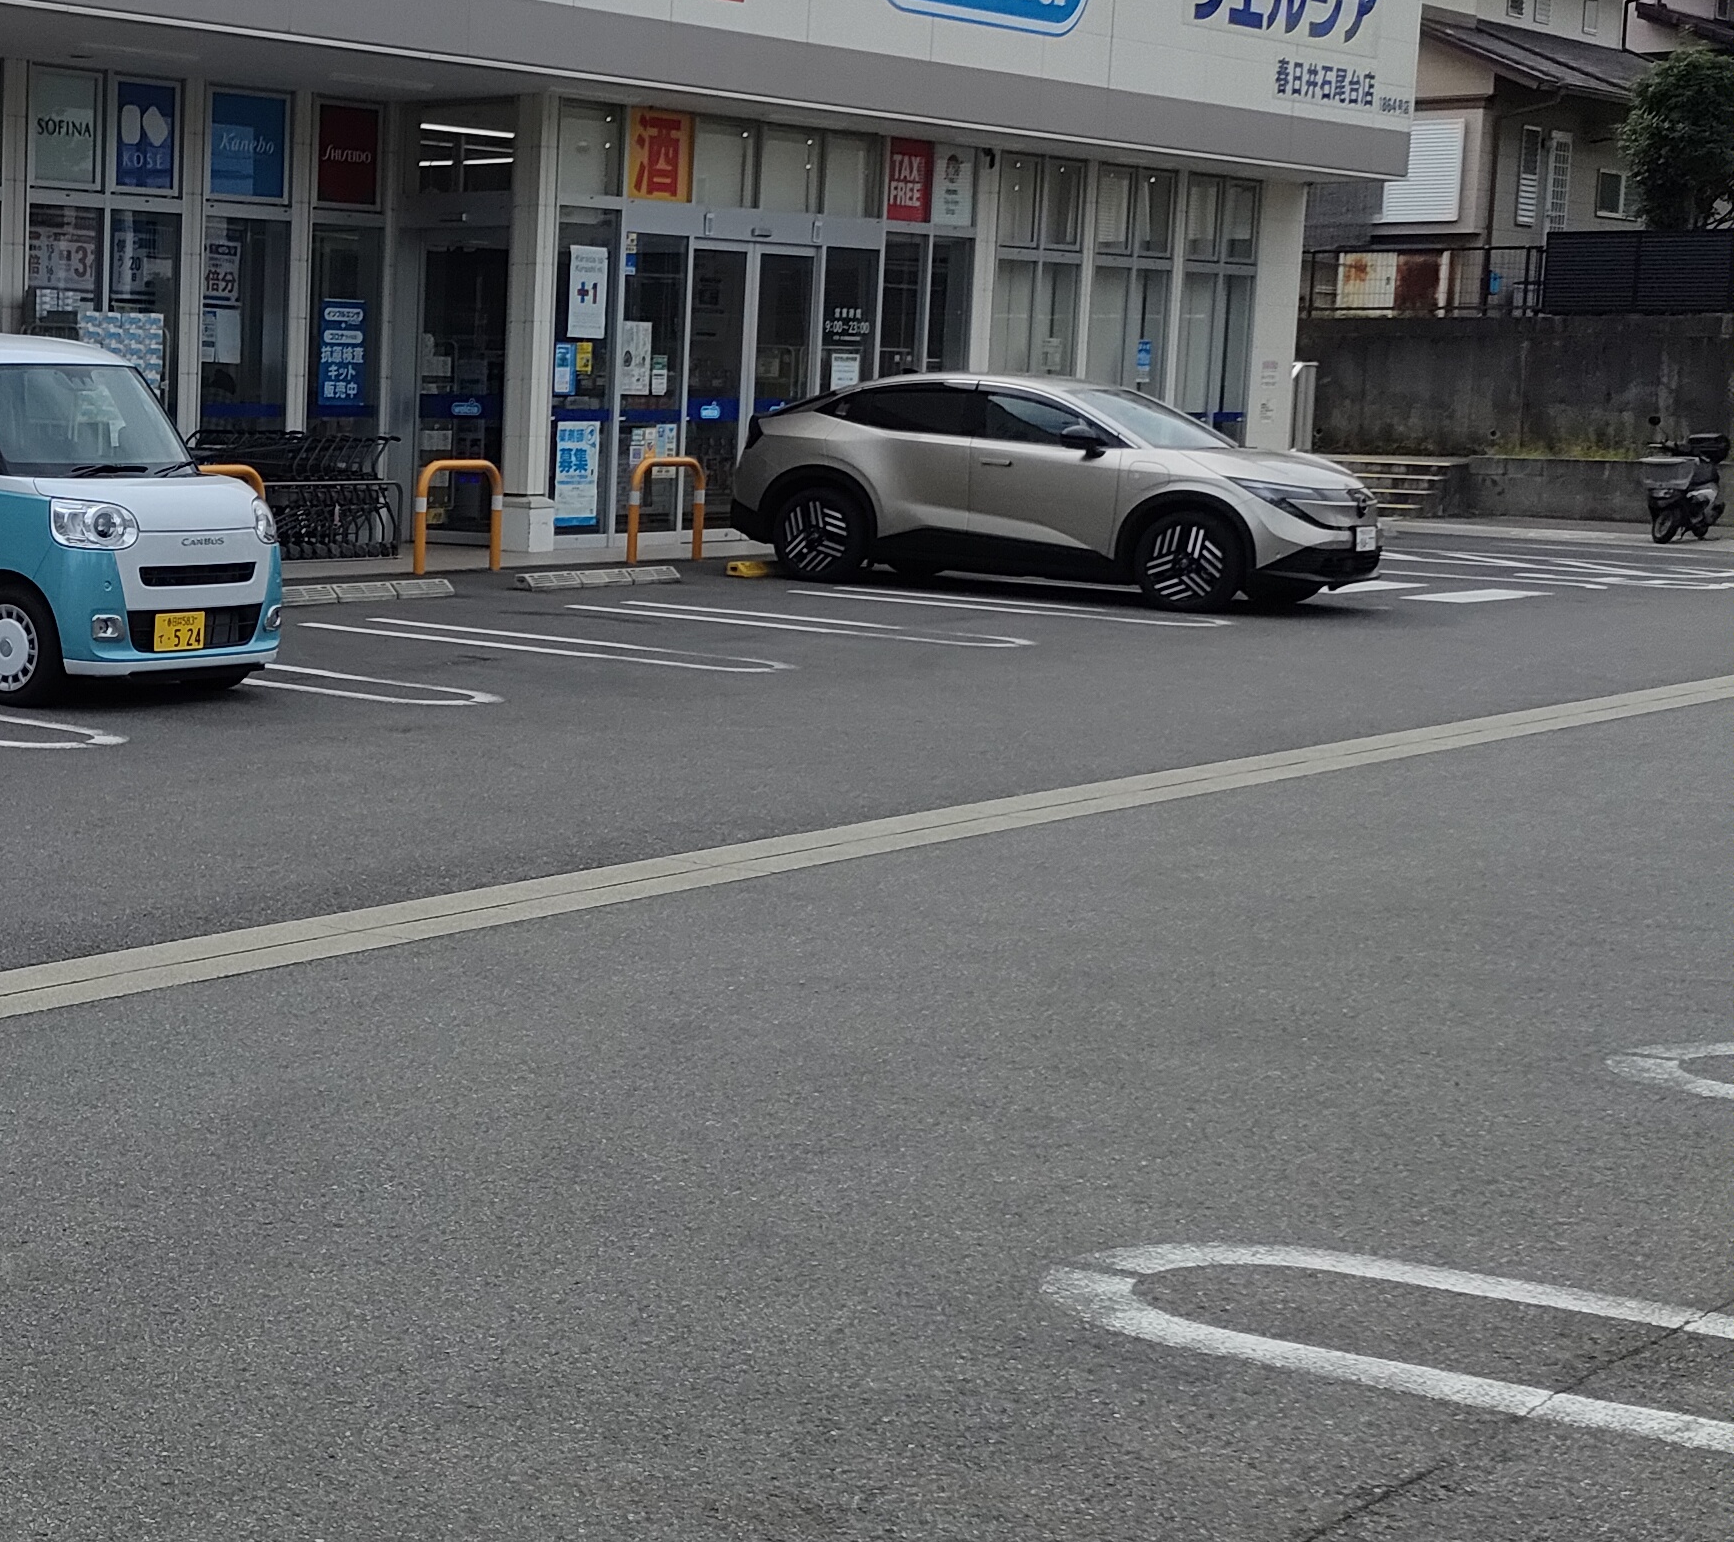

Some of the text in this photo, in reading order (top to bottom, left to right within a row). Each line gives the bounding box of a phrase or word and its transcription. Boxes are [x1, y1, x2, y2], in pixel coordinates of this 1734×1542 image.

[1275, 57, 1376, 108] 春日井石尾台店
[36, 117, 92, 139] SOFINA
[219, 132, 276, 156] Kanebo
[322, 144, 373, 164] SHISEIDO
[633, 112, 683, 199] 酒
[893, 153, 920, 181] TAX
[889, 180, 921, 207] FREE
[327, 364, 356, 380] キット
[323, 381, 358, 399] 販売中
[558, 447, 588, 474] 募集
[181, 536, 225, 547] CANBUS
